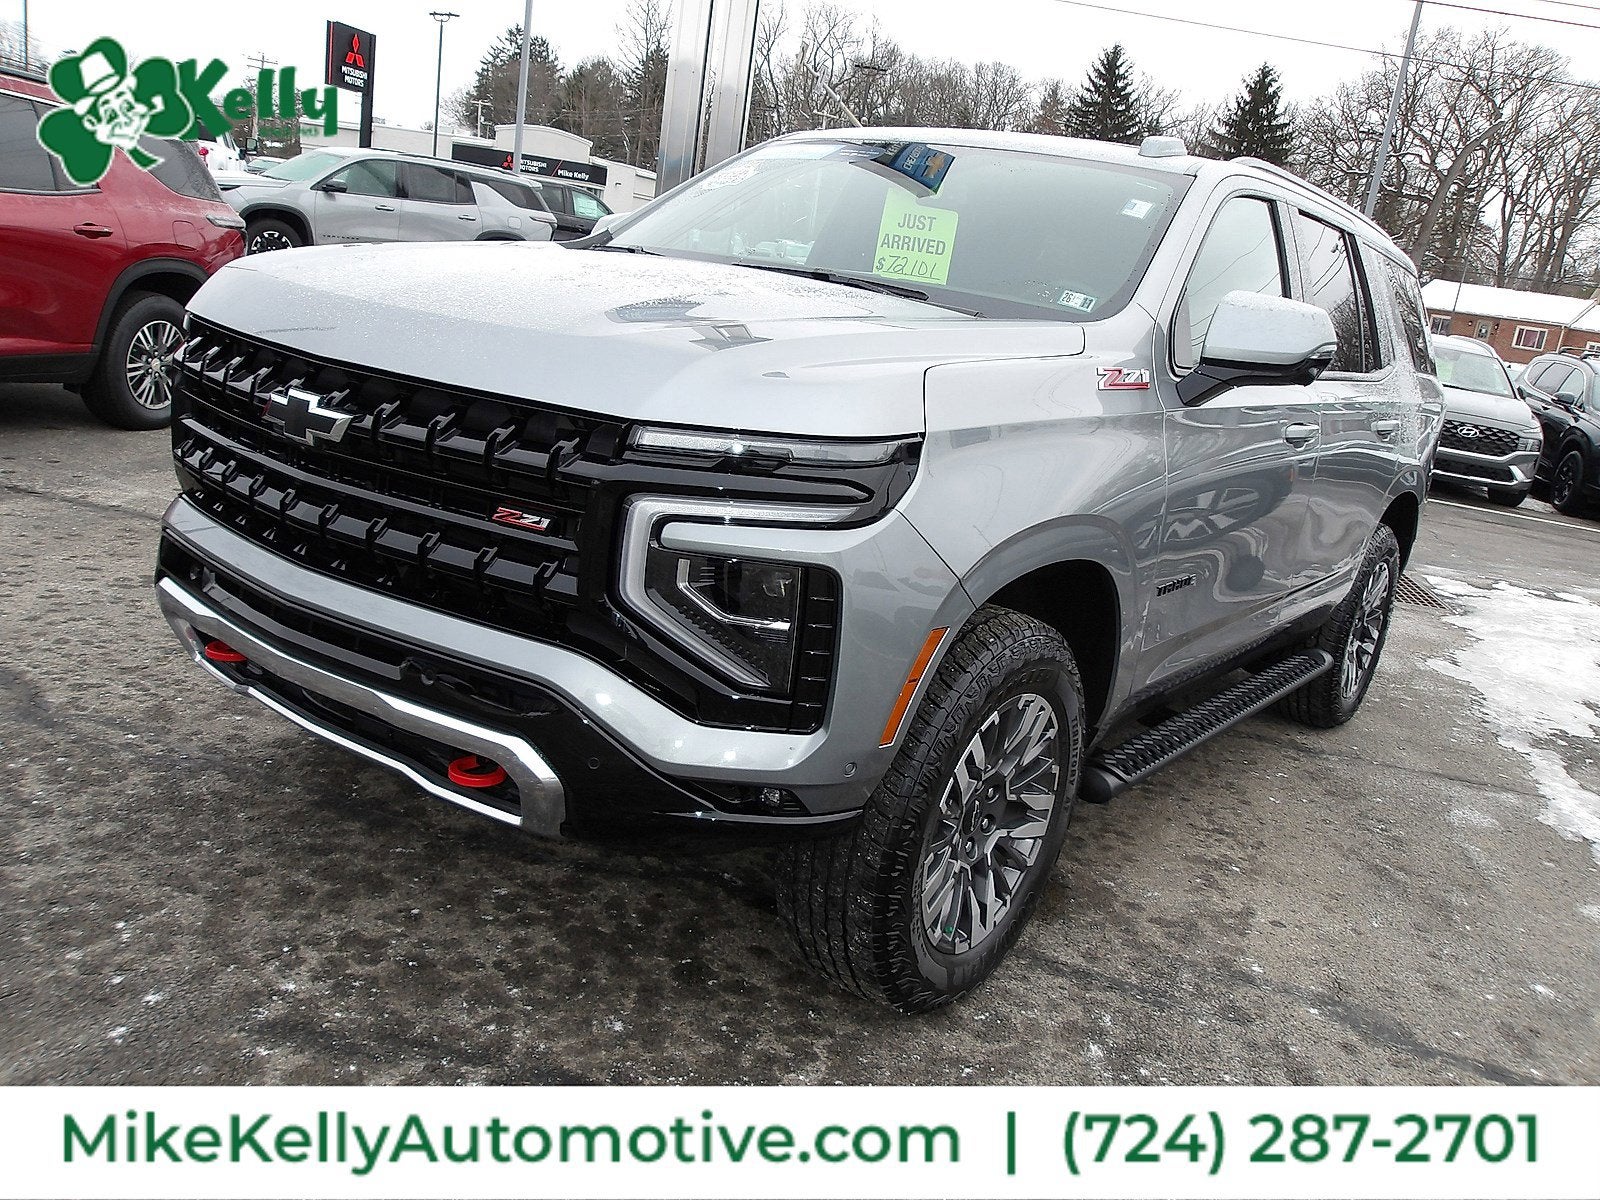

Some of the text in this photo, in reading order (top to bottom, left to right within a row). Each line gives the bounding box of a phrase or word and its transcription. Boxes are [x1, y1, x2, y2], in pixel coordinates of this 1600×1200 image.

[341, 65, 368, 80] MITSUBISHI
[344, 75, 365, 88] MOTORS
[557, 169, 590, 181] Mike Kelly
[897, 213, 937, 232] JUST
[880, 233, 946, 256] ARRIVED
[1061, 292, 1074, 303] 26
[1096, 366, 1151, 391] Z71
[491, 506, 551, 531] Z71
